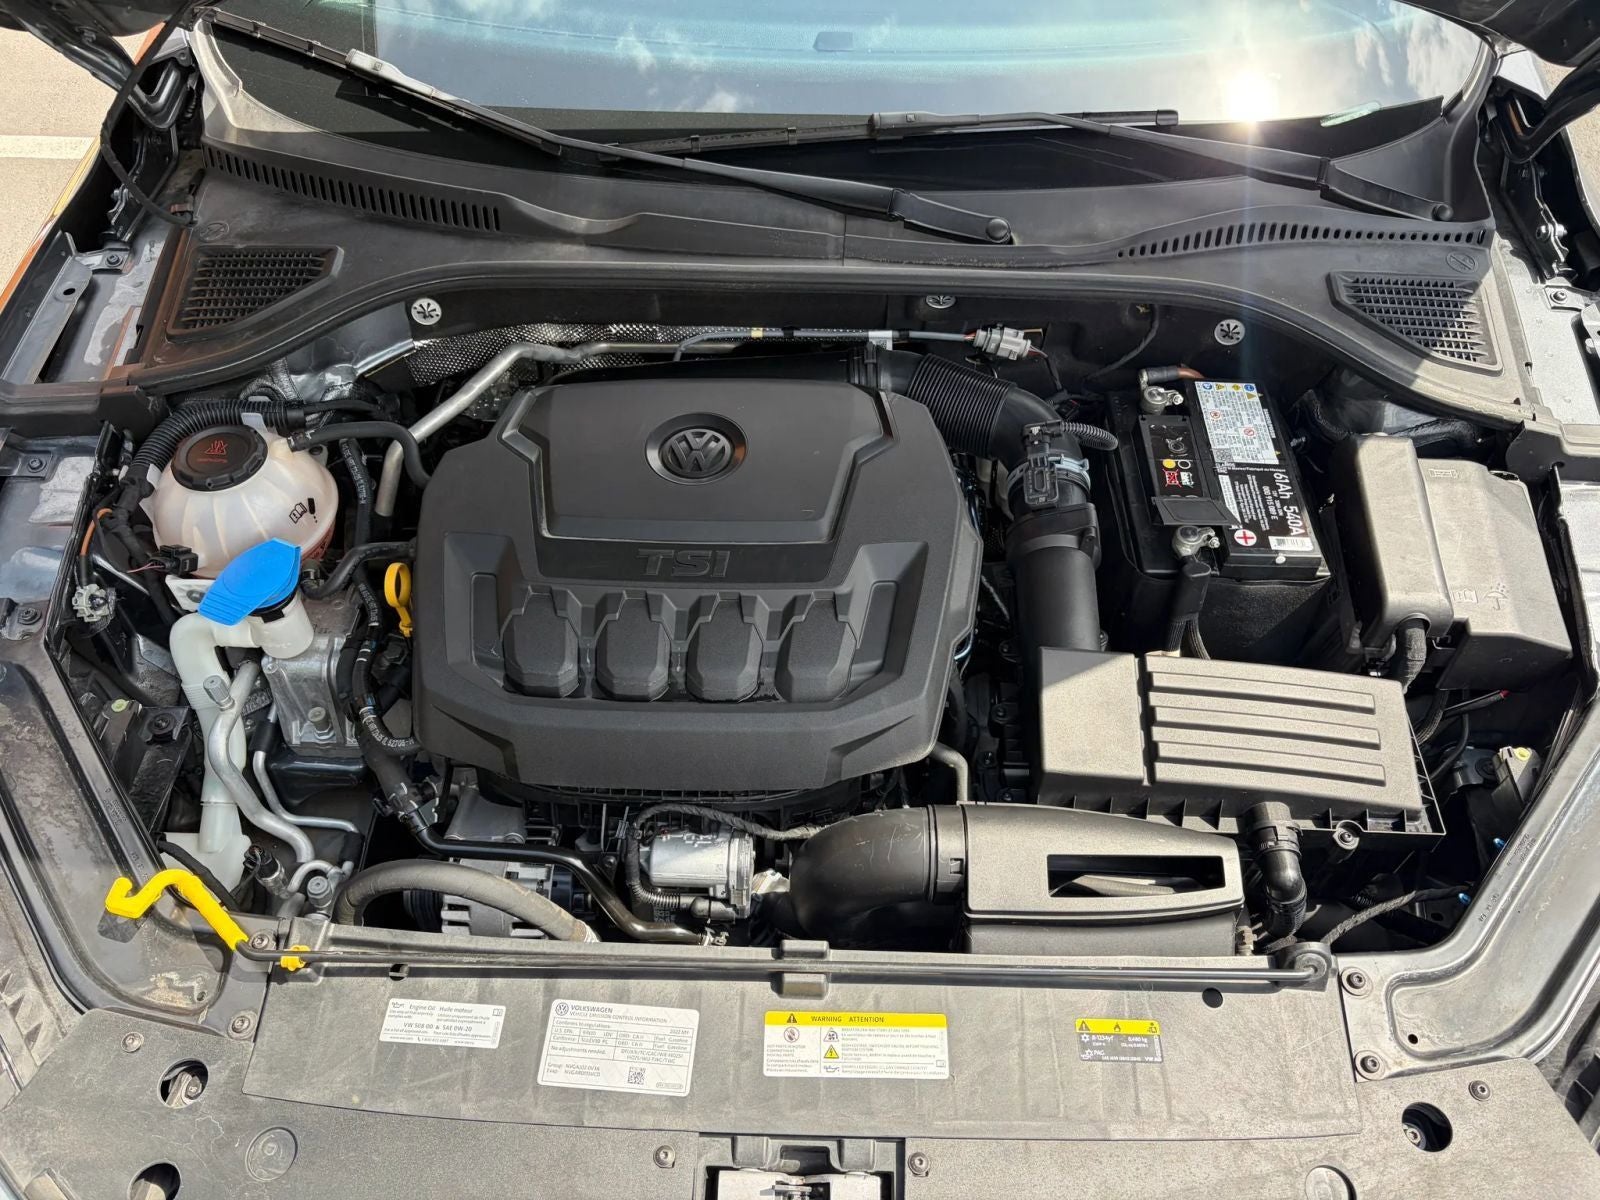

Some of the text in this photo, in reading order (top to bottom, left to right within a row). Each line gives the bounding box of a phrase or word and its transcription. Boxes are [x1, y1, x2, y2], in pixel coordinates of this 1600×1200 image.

[1274, 472, 1306, 536] 61Ah 540A
[636, 548, 730, 578] TSI
[571, 1005, 613, 1013] VOLKSWAGEN
